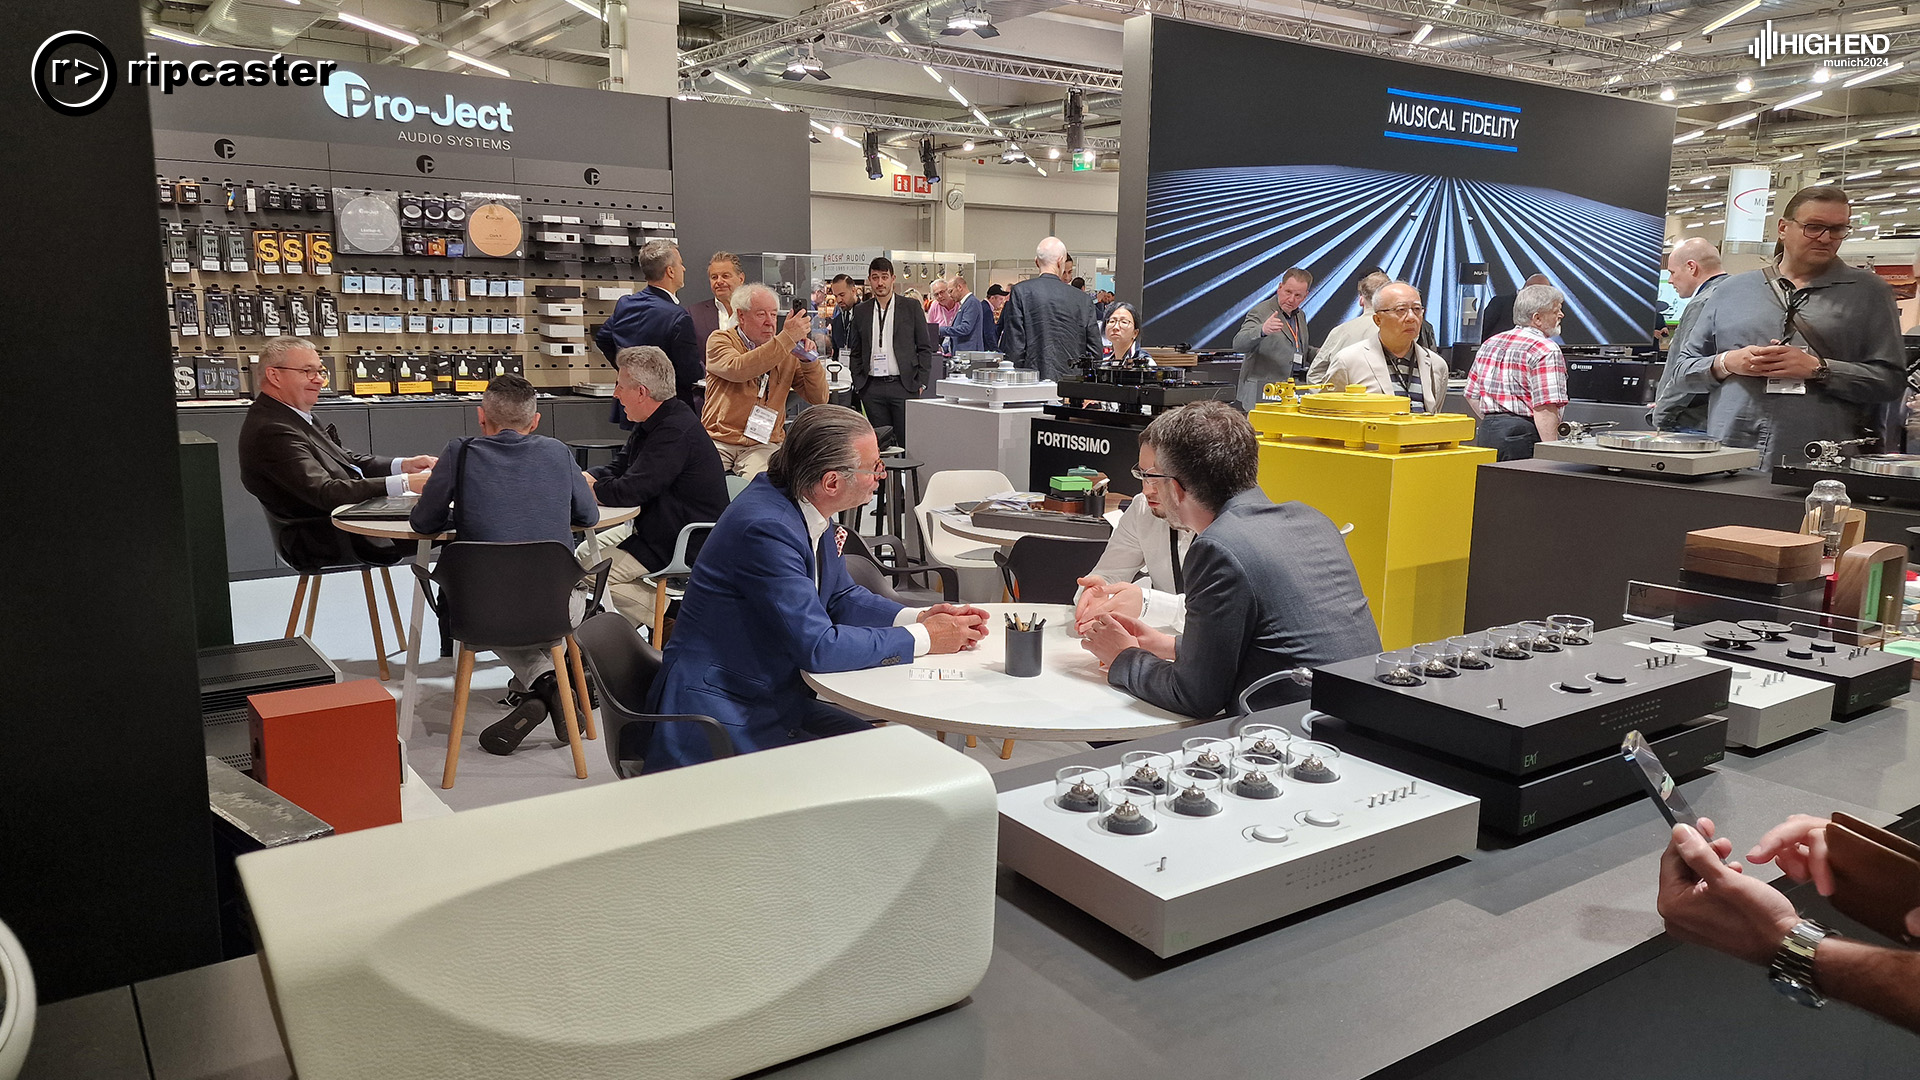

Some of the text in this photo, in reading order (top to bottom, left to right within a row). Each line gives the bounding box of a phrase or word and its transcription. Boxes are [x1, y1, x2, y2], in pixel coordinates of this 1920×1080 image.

[323, 71, 514, 132] Pro-Ject
[1388, 101, 1519, 139] MUSICAL FIDELITY
[398, 131, 511, 150] AUDIO SYSTEMS
[1037, 430, 1110, 455] FORTISSIMO
